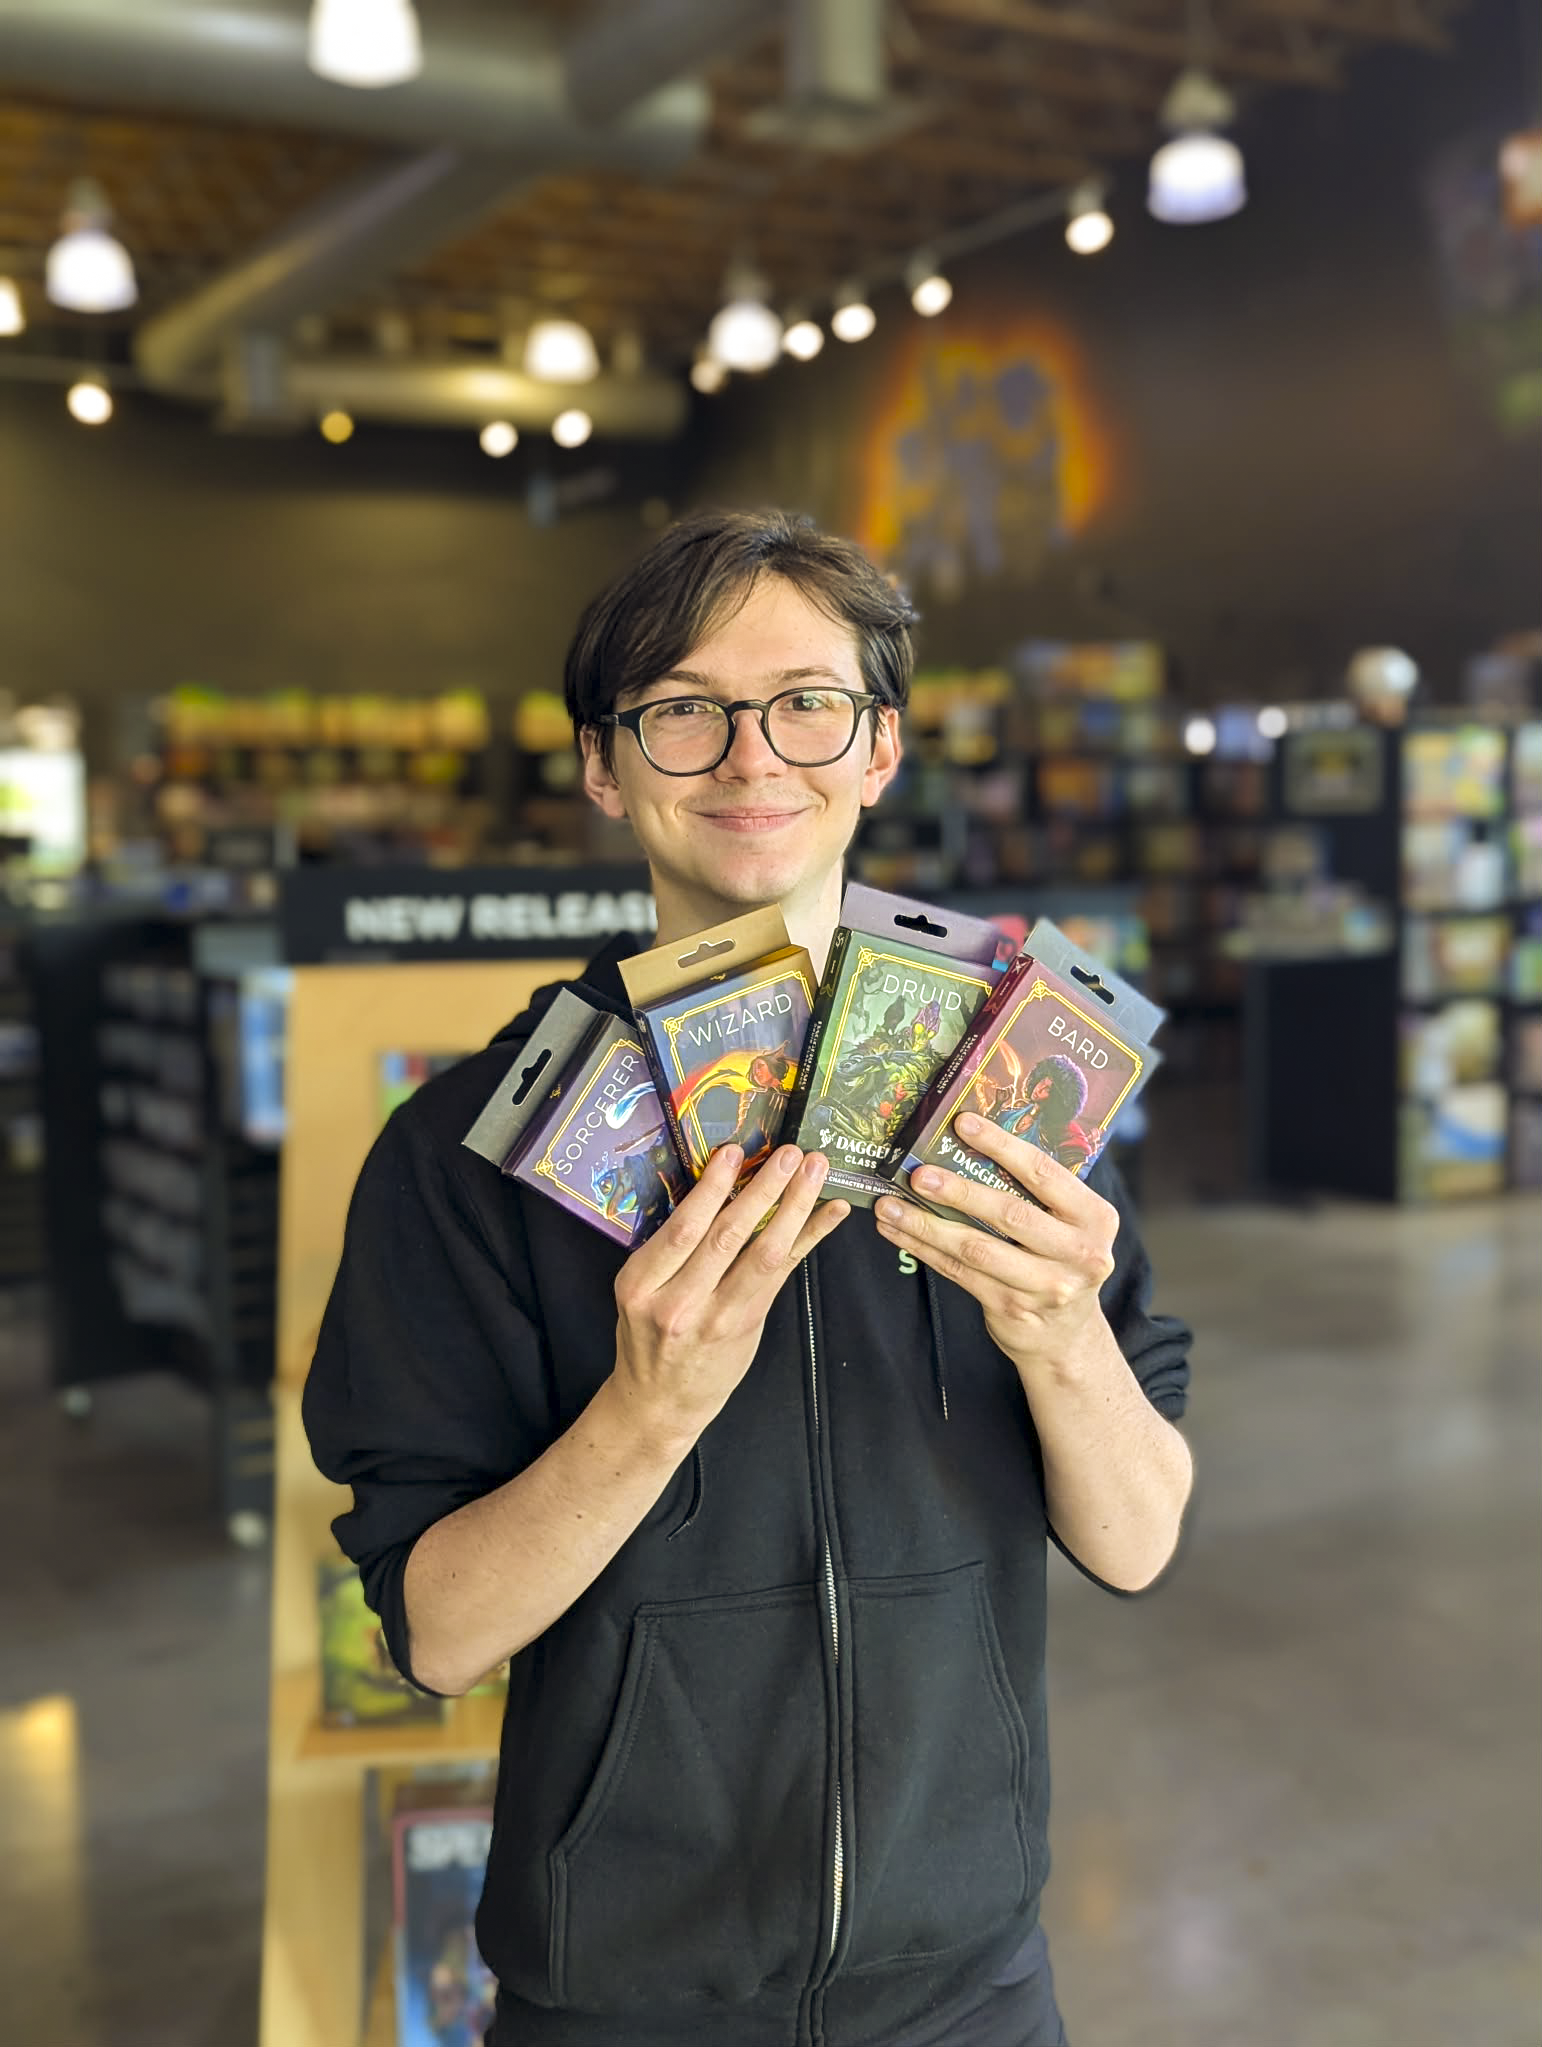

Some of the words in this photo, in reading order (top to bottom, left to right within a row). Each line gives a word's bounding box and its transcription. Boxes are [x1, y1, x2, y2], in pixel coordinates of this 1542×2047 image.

[344, 895, 464, 942] NEW
[883, 974, 962, 1012] DRUID
[688, 992, 793, 1048] WIZARD
[1048, 1016, 1109, 1071] BARD
[556, 1053, 640, 1176] SORCERER
[844, 1154, 878, 1169] CLASS
[828, 1176, 865, 1190] CHARACTER
[865, 1184, 873, 1192] IN
[898, 1248, 918, 1275] S
